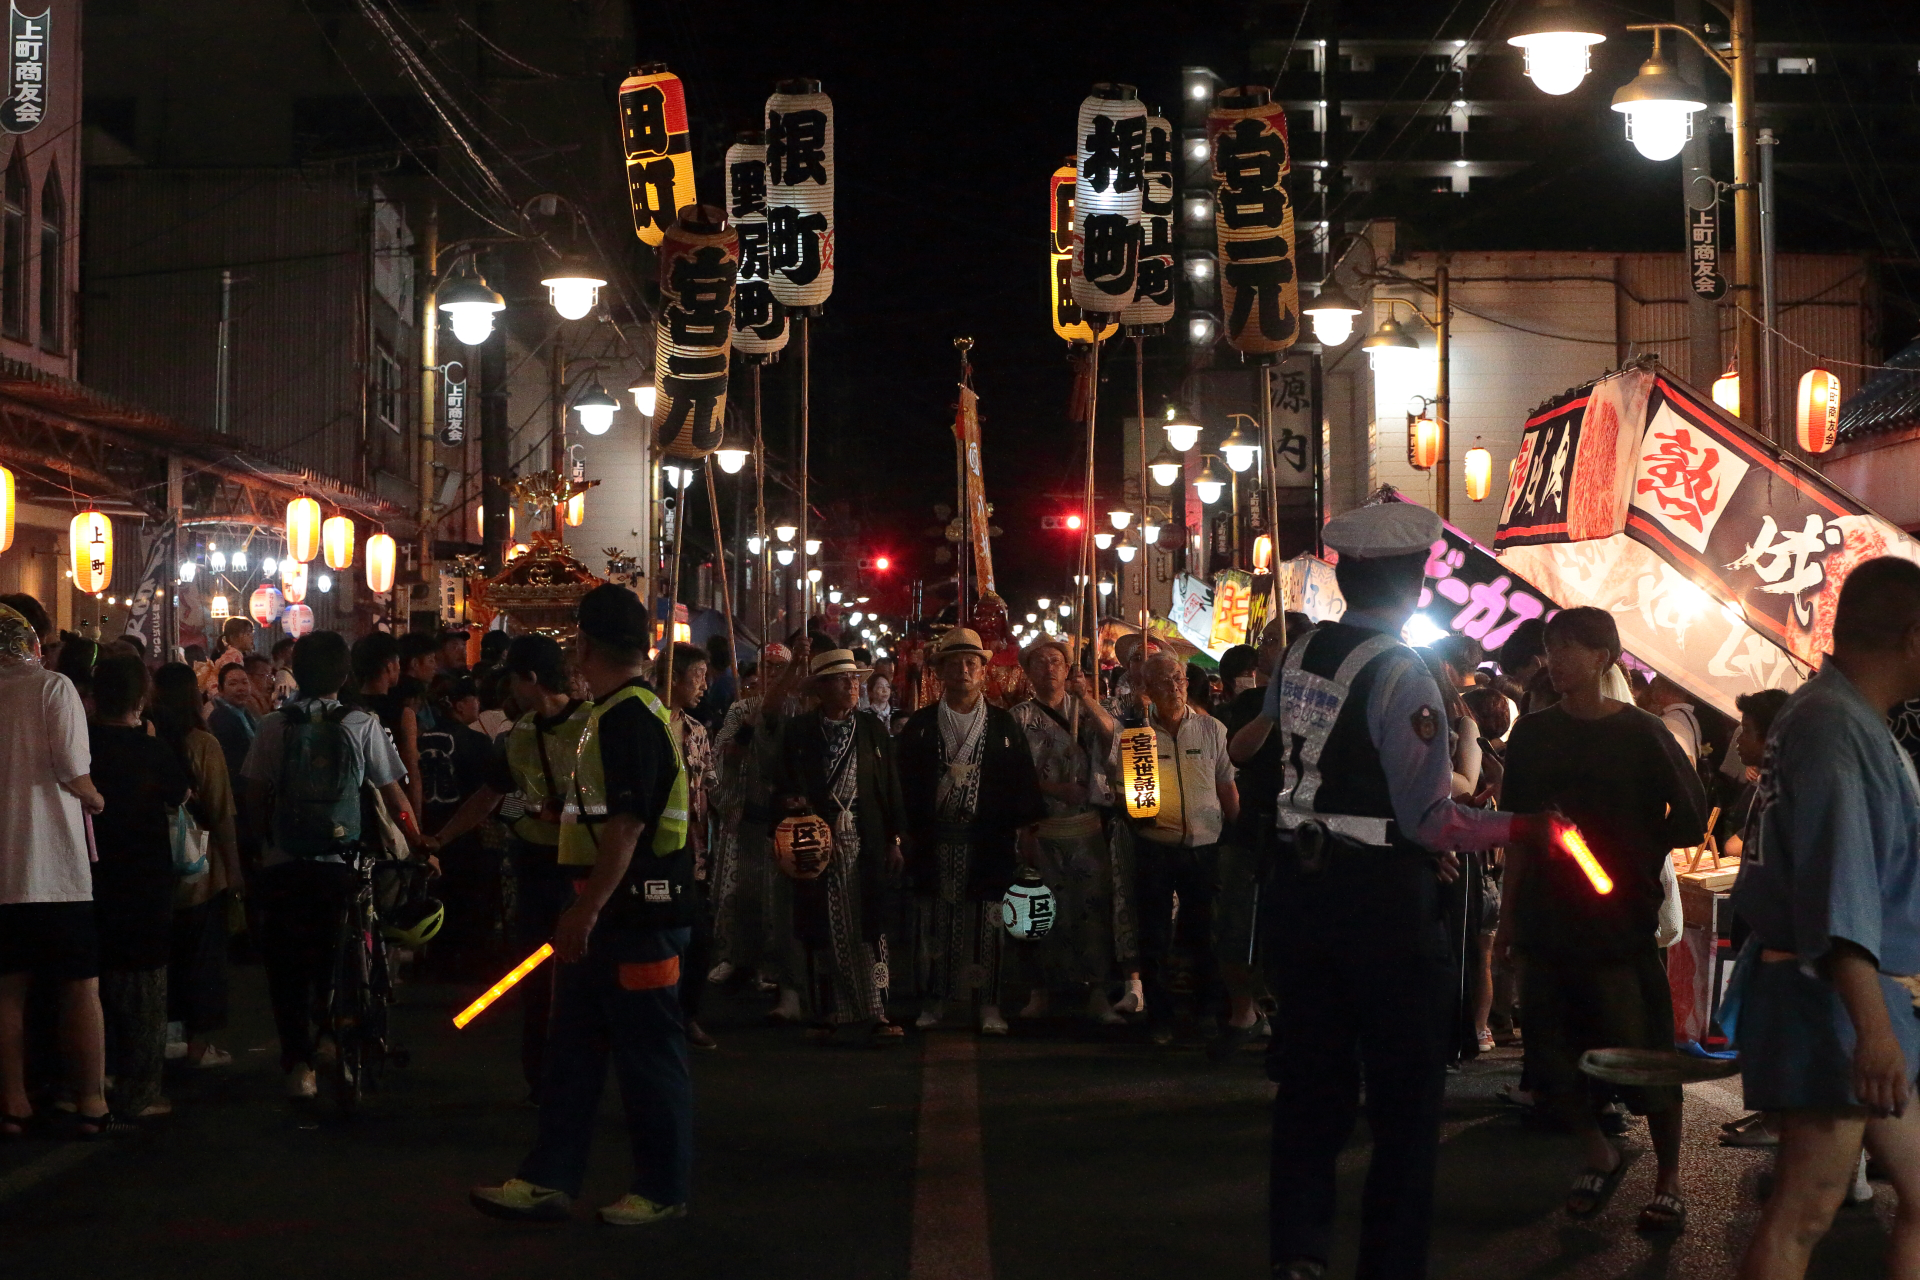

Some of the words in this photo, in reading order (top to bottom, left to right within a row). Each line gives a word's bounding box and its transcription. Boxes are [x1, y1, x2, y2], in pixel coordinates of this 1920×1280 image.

[15, 20, 42, 123] 上町商友会
[620, 85, 675, 232] 田町
[767, 110, 828, 285] 根町
[1082, 115, 1147, 294] 根町
[1694, 212, 1715, 294] 上町商友会
[448, 385, 463, 441] 上町商友会
[90, 526, 106, 576] 上町
[1131, 733, 1156, 809] 宮元世話係
[790, 822, 821, 873] 区長
[1025, 893, 1052, 938] 区長
